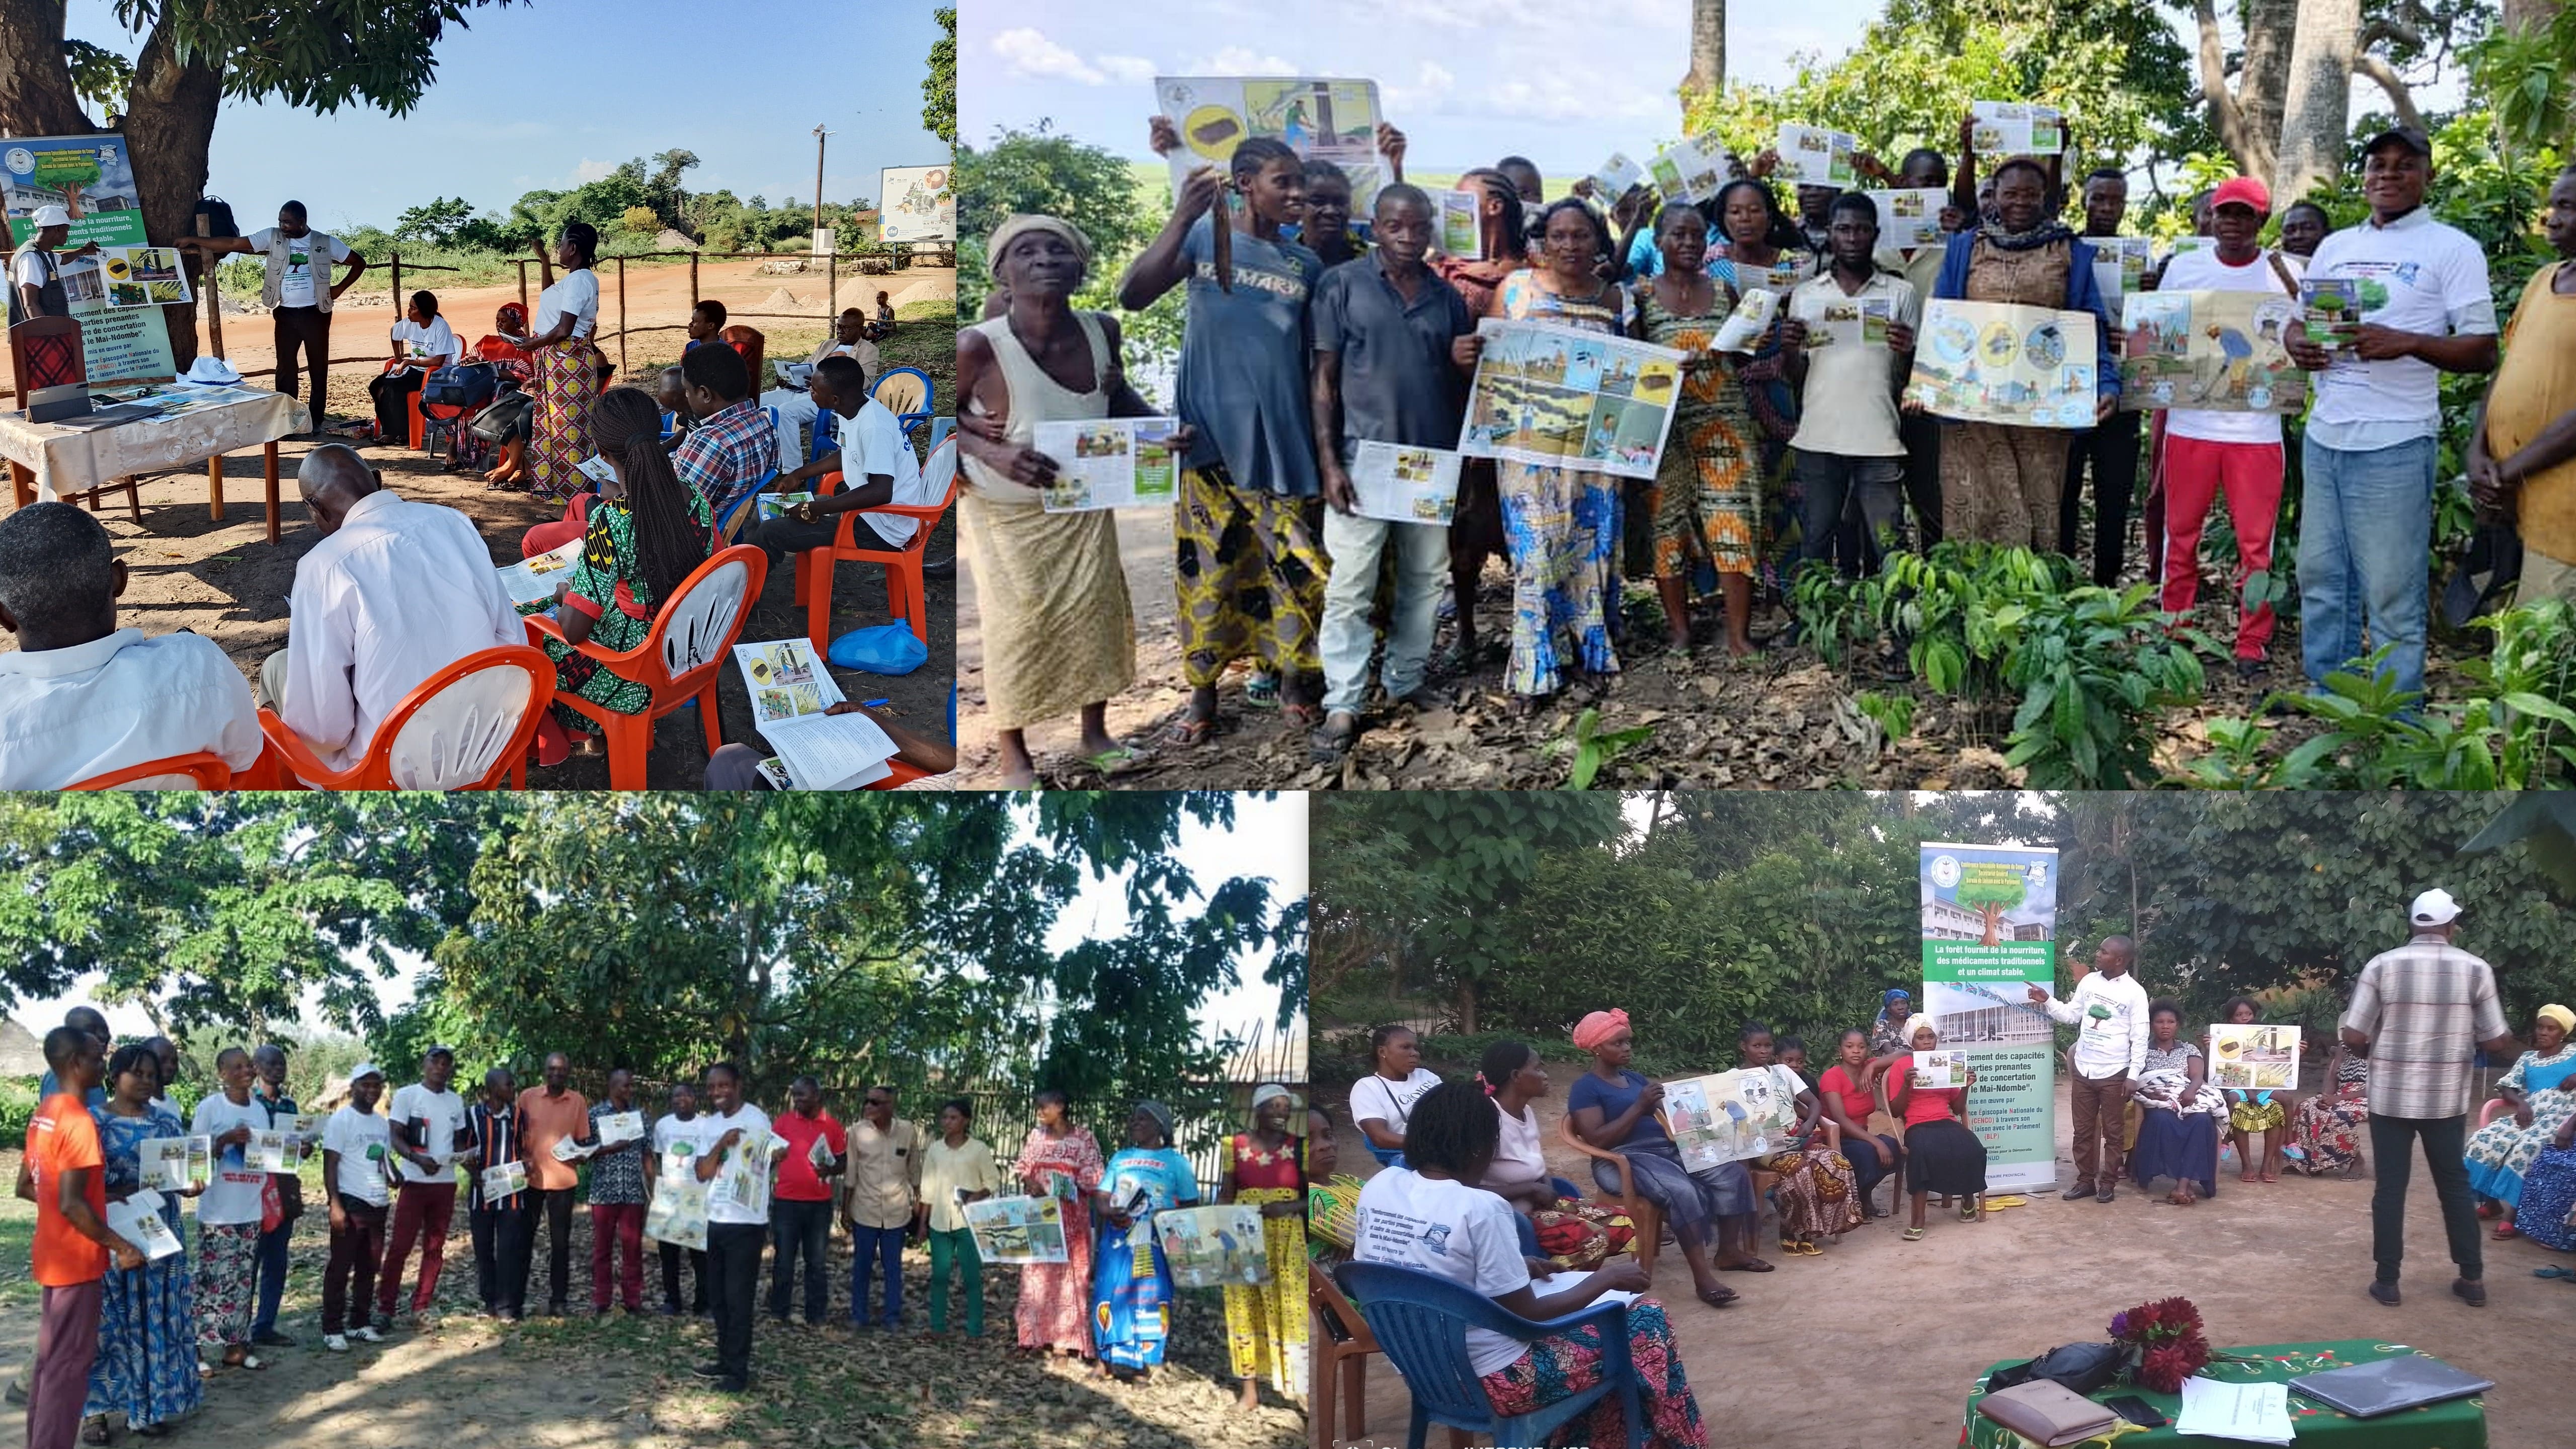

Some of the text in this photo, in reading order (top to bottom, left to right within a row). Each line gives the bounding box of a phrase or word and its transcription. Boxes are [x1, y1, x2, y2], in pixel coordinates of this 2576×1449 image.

[96, 215, 132, 224] nourriture,
[90, 224, 132, 233] traditionnels
[69, 237, 91, 246] climat
[92, 235, 115, 243] stable.
[105, 313, 140, 325] prenantes
[103, 321, 146, 333] concertation
[129, 349, 152, 358] Nationale
[95, 362, 117, 371] (CENCO)
[123, 358, 140, 366] travers
[97, 370, 115, 378] Liaison
[136, 362, 160, 370] Parlement
[1946, 945, 1963, 953] forêt
[2009, 946, 2047, 955] nourriture,
[1937, 956, 2045, 965] des médicaments traditionnels
[2001, 968, 2026, 976] stable.
[2010, 1052, 2045, 1061] capacités
[1995, 1063, 2031, 1072] prenantes
[1990, 1073, 2036, 1082] concertation
[1979, 1108, 2007, 1116] Épiscopale
[1971, 1117, 1994, 1125] (CENCO)
[1984, 1133, 1999, 1141] (BLP)
